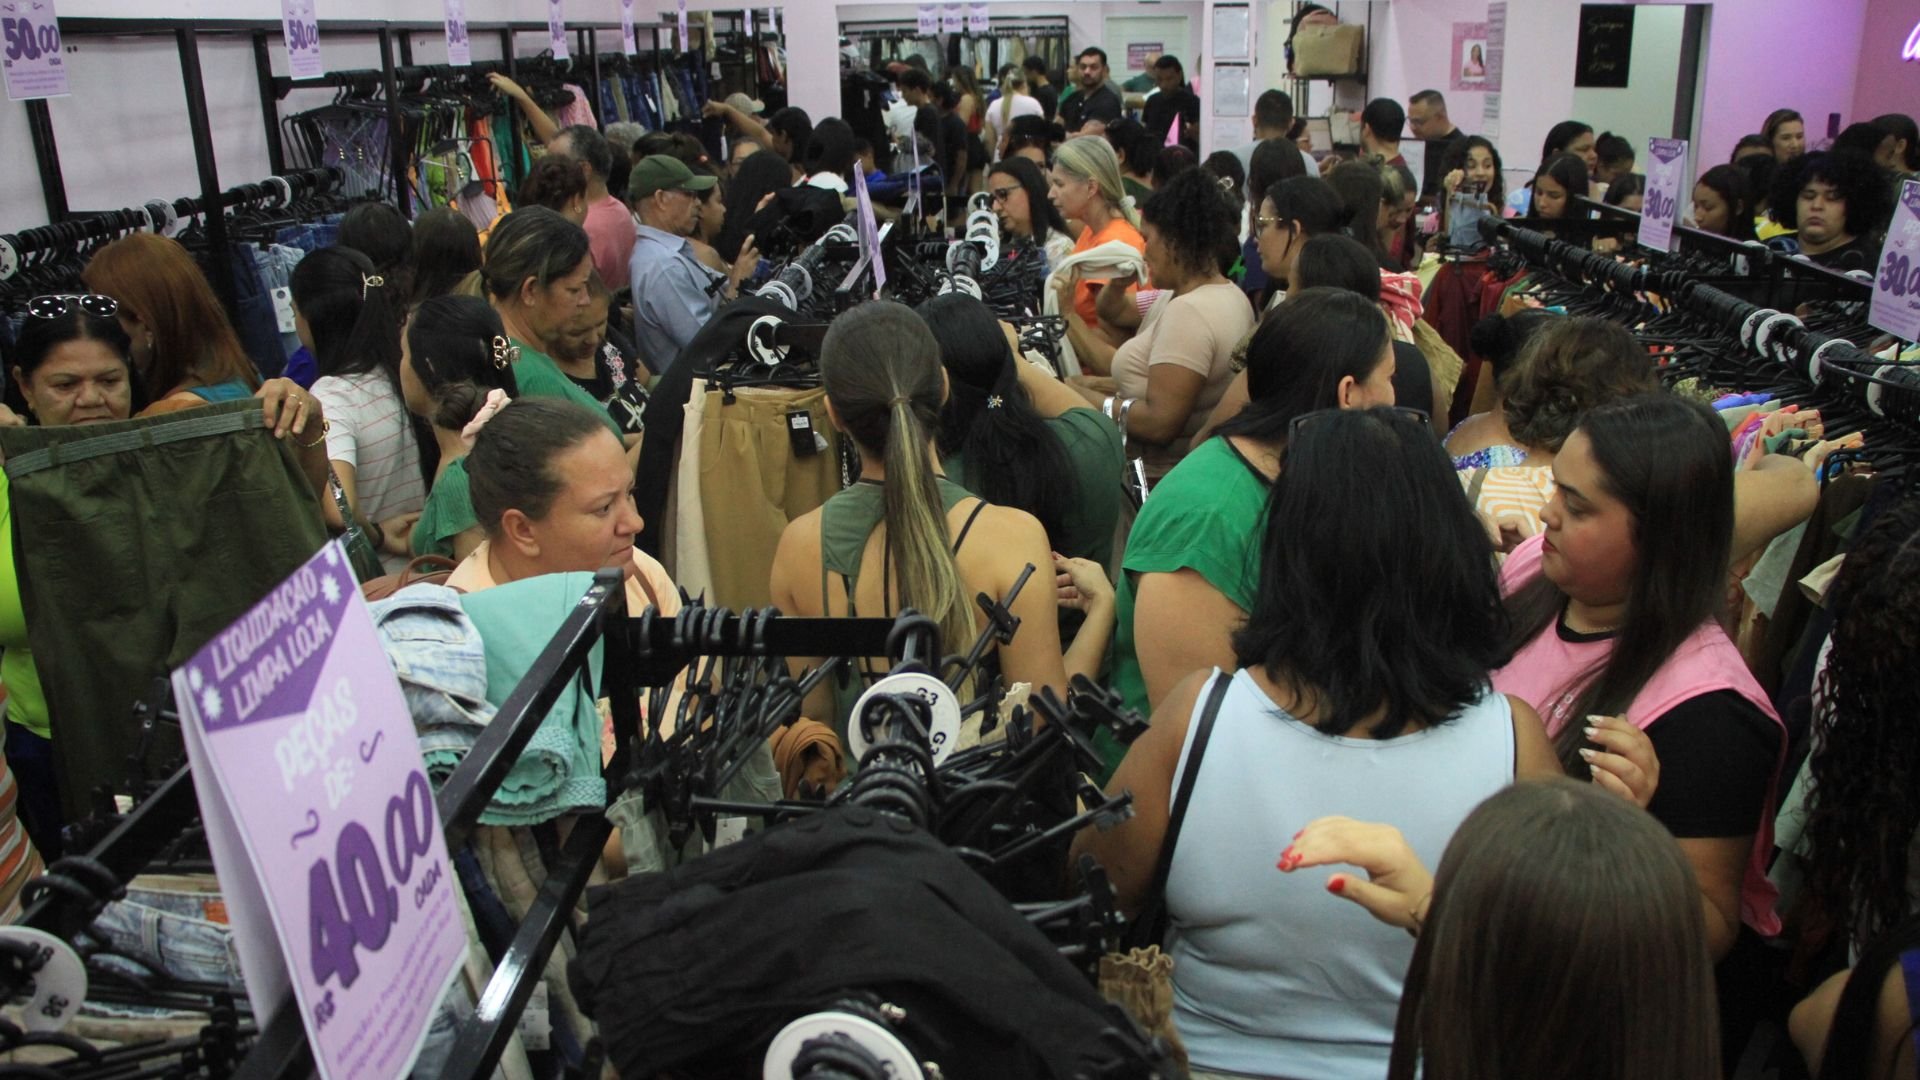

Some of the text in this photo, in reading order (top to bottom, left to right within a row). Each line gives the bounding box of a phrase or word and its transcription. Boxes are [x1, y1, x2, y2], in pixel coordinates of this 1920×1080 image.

[231, 608, 334, 722] LIMPA LOJA
[274, 676, 359, 794] PEÇAS
[415, 859, 442, 910] CADA
[314, 989, 336, 1031] R$
